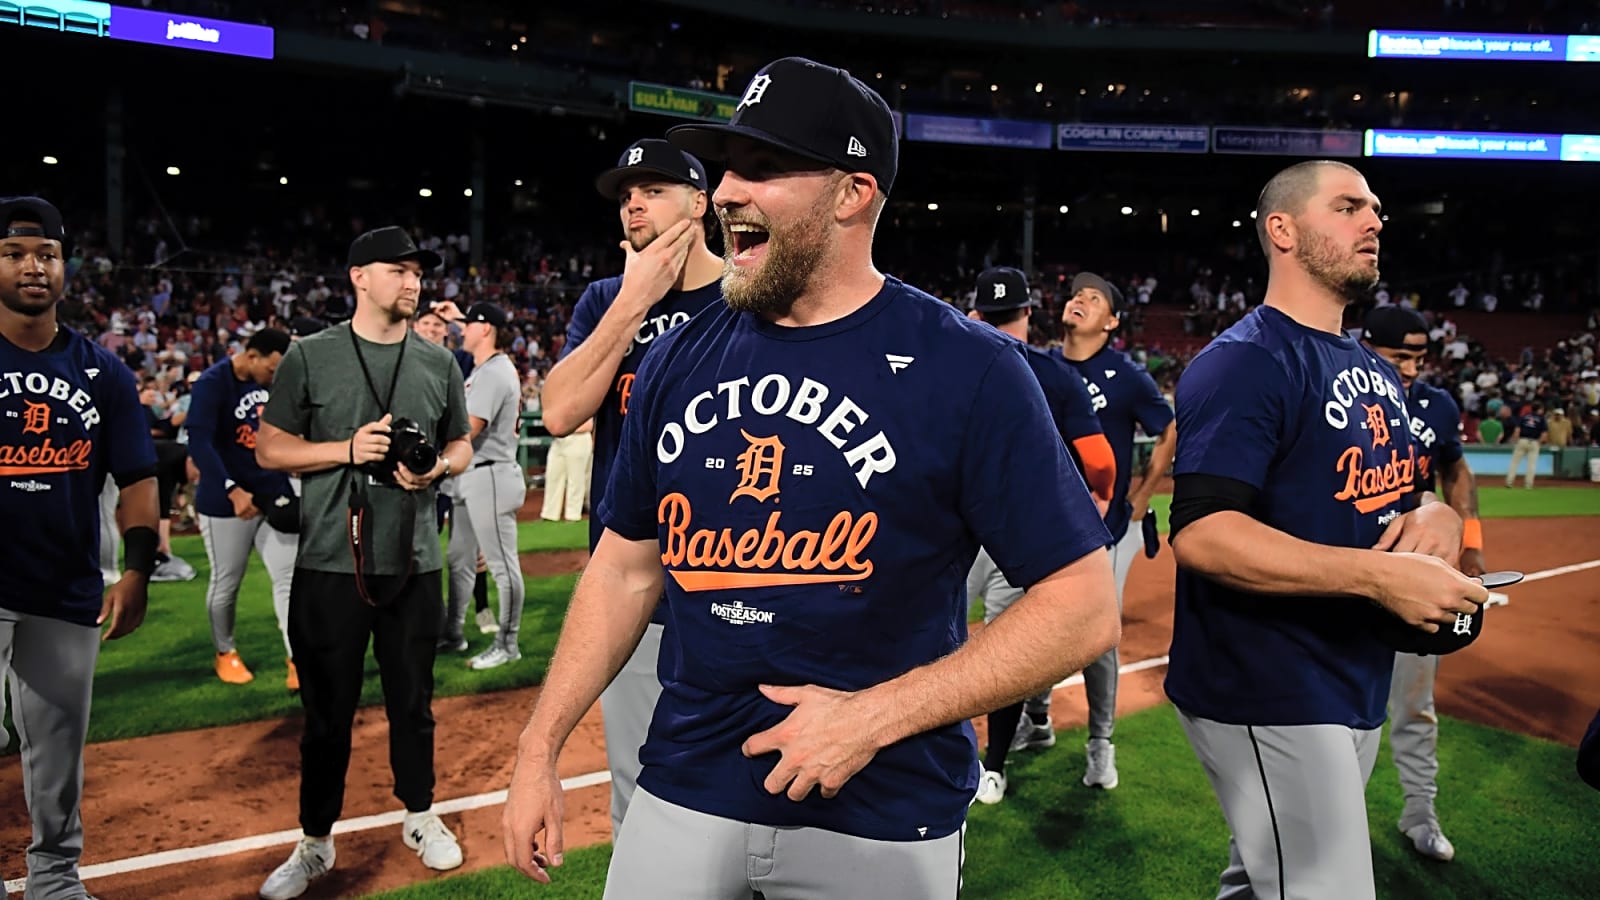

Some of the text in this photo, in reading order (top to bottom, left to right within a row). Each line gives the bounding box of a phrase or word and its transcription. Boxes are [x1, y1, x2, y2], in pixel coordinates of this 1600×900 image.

[1485, 41, 1511, 53] your
[1062, 126, 1207, 142] COGHLIN COMPANIES
[657, 373, 897, 490] OCTOBER
[705, 428, 814, 504] 20 D 25
[658, 492, 879, 578] Baseball
[711, 602, 774, 624] POSTSEASON
